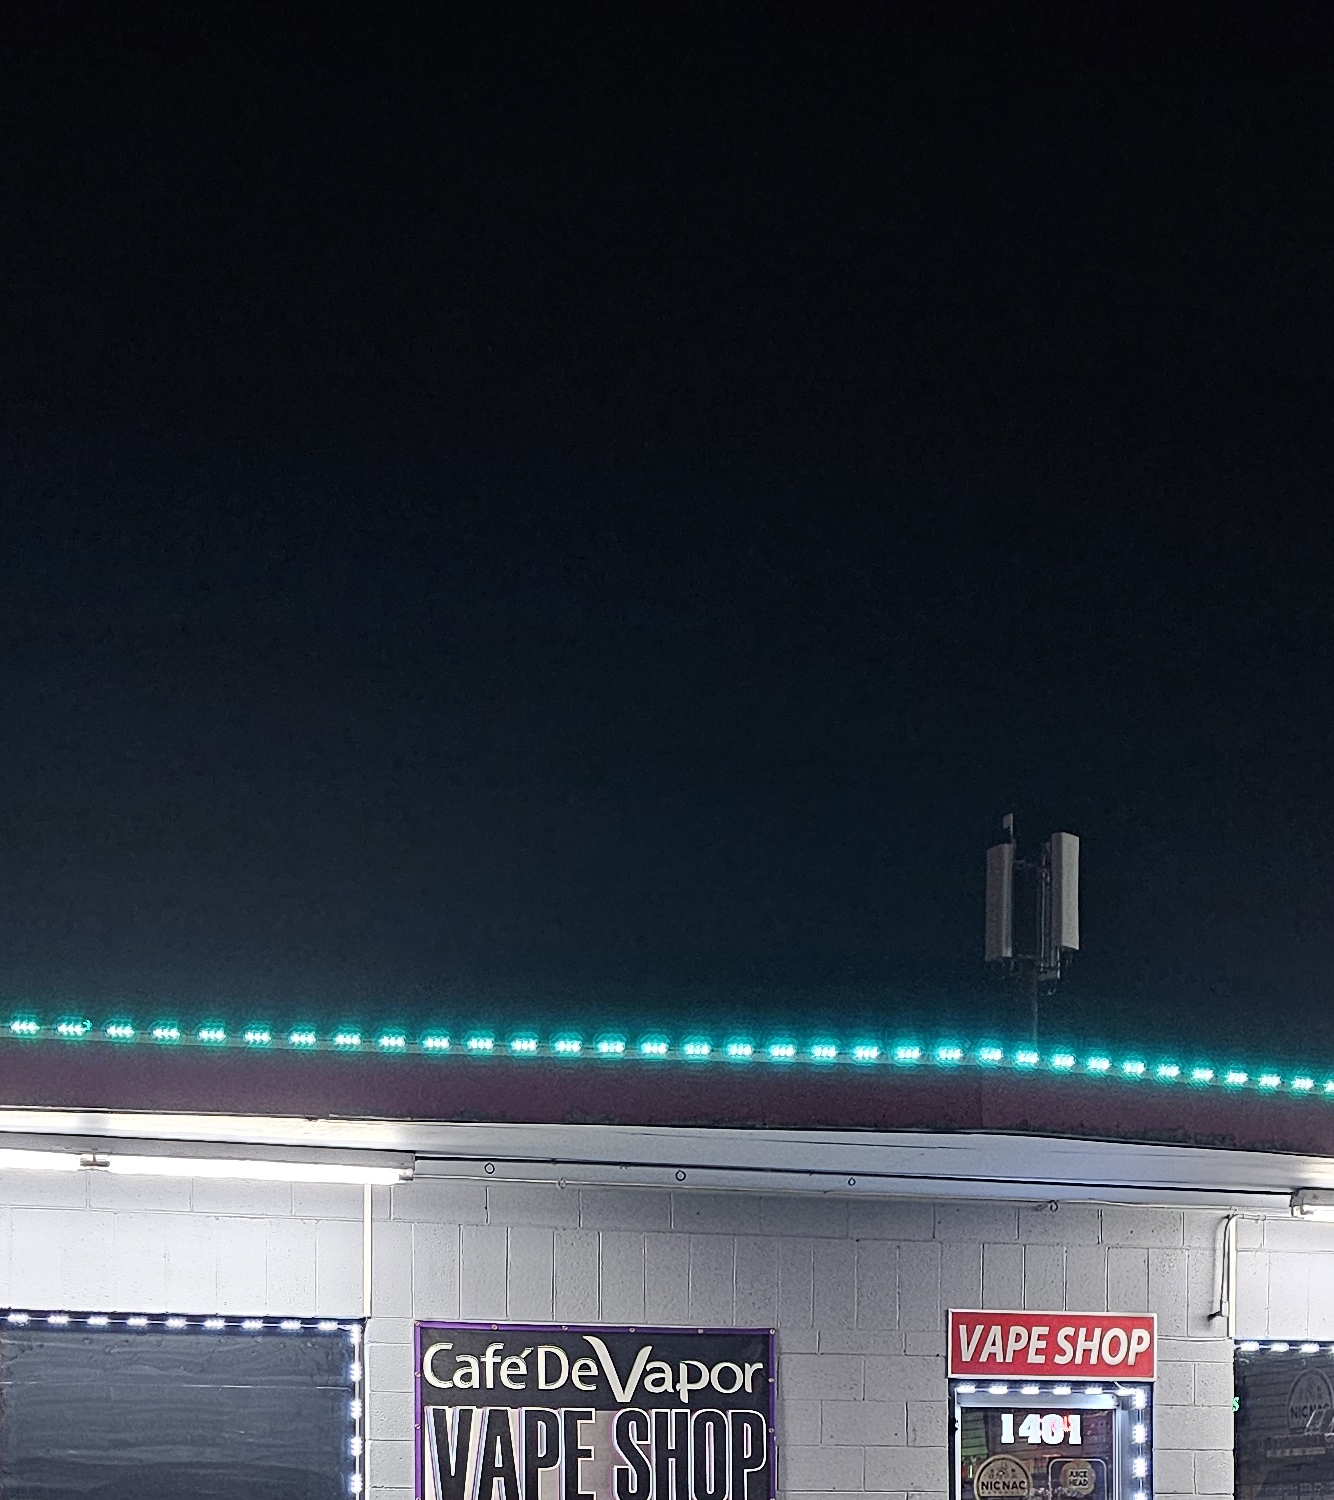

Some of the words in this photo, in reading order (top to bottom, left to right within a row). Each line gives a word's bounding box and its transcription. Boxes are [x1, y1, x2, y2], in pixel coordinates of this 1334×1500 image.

[958, 1324, 1049, 1363] VAPE
[1053, 1326, 1151, 1366] SHOP
[422, 1342, 534, 1390] Café
[537, 1345, 599, 1391] De
[583, 1335, 764, 1404] Vapor
[1000, 1413, 1082, 1445] 1401
